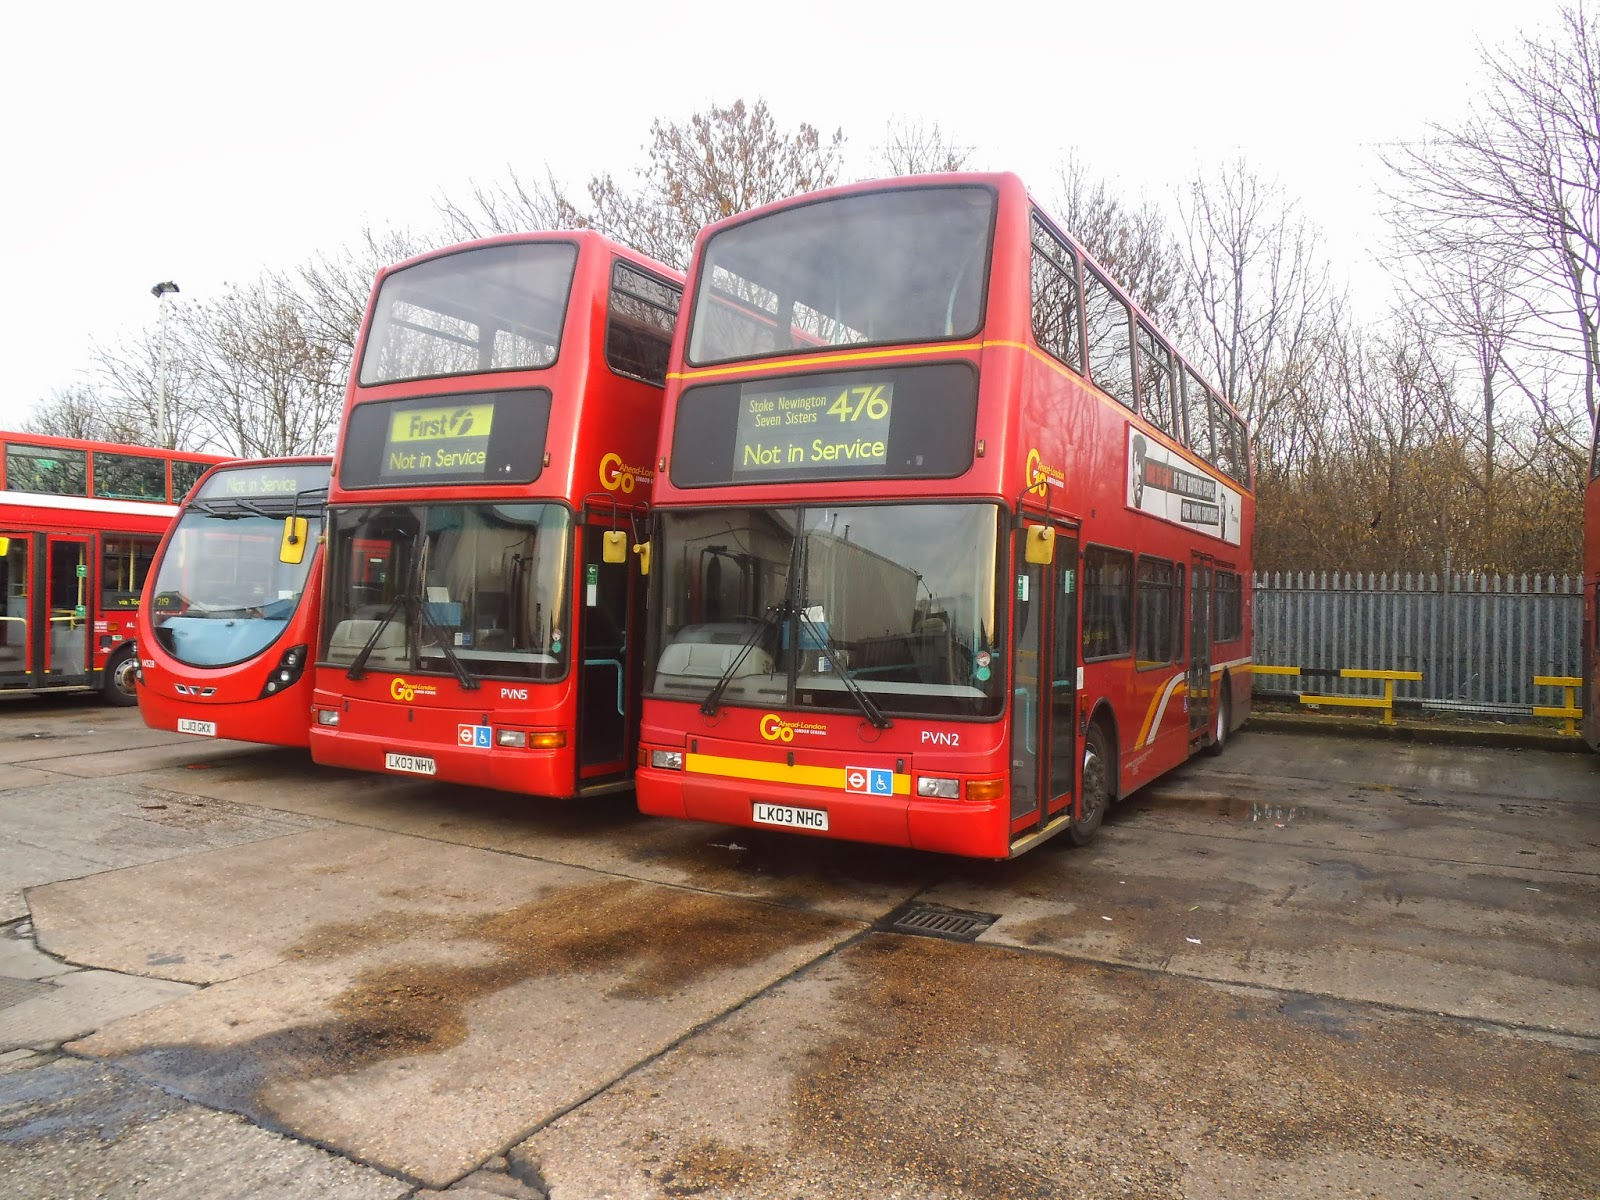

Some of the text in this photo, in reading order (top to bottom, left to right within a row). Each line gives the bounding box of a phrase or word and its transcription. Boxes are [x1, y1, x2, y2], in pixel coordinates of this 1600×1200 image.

[749, 396, 826, 413] Stoke Newington
[826, 385, 889, 422] 476
[409, 414, 448, 438] First
[755, 412, 817, 427] Seven Sisters
[389, 448, 486, 470] Not in Service
[743, 438, 885, 466] Not in Service
[599, 452, 635, 494] Go
[1026, 448, 1047, 497] Go
[226, 475, 296, 493] Not in Service
[157, 597, 169, 606] 219
[390, 677, 415, 702] Go
[500, 687, 528, 700] PVN5
[197, 722, 211, 733] GKX
[760, 713, 794, 742] Go
[778, 720, 827, 731] Ahead-London
[921, 731, 960, 746] PVN2
[389, 755, 434, 773] LK03 NHV
[758, 805, 823, 827] LK03 NHG
